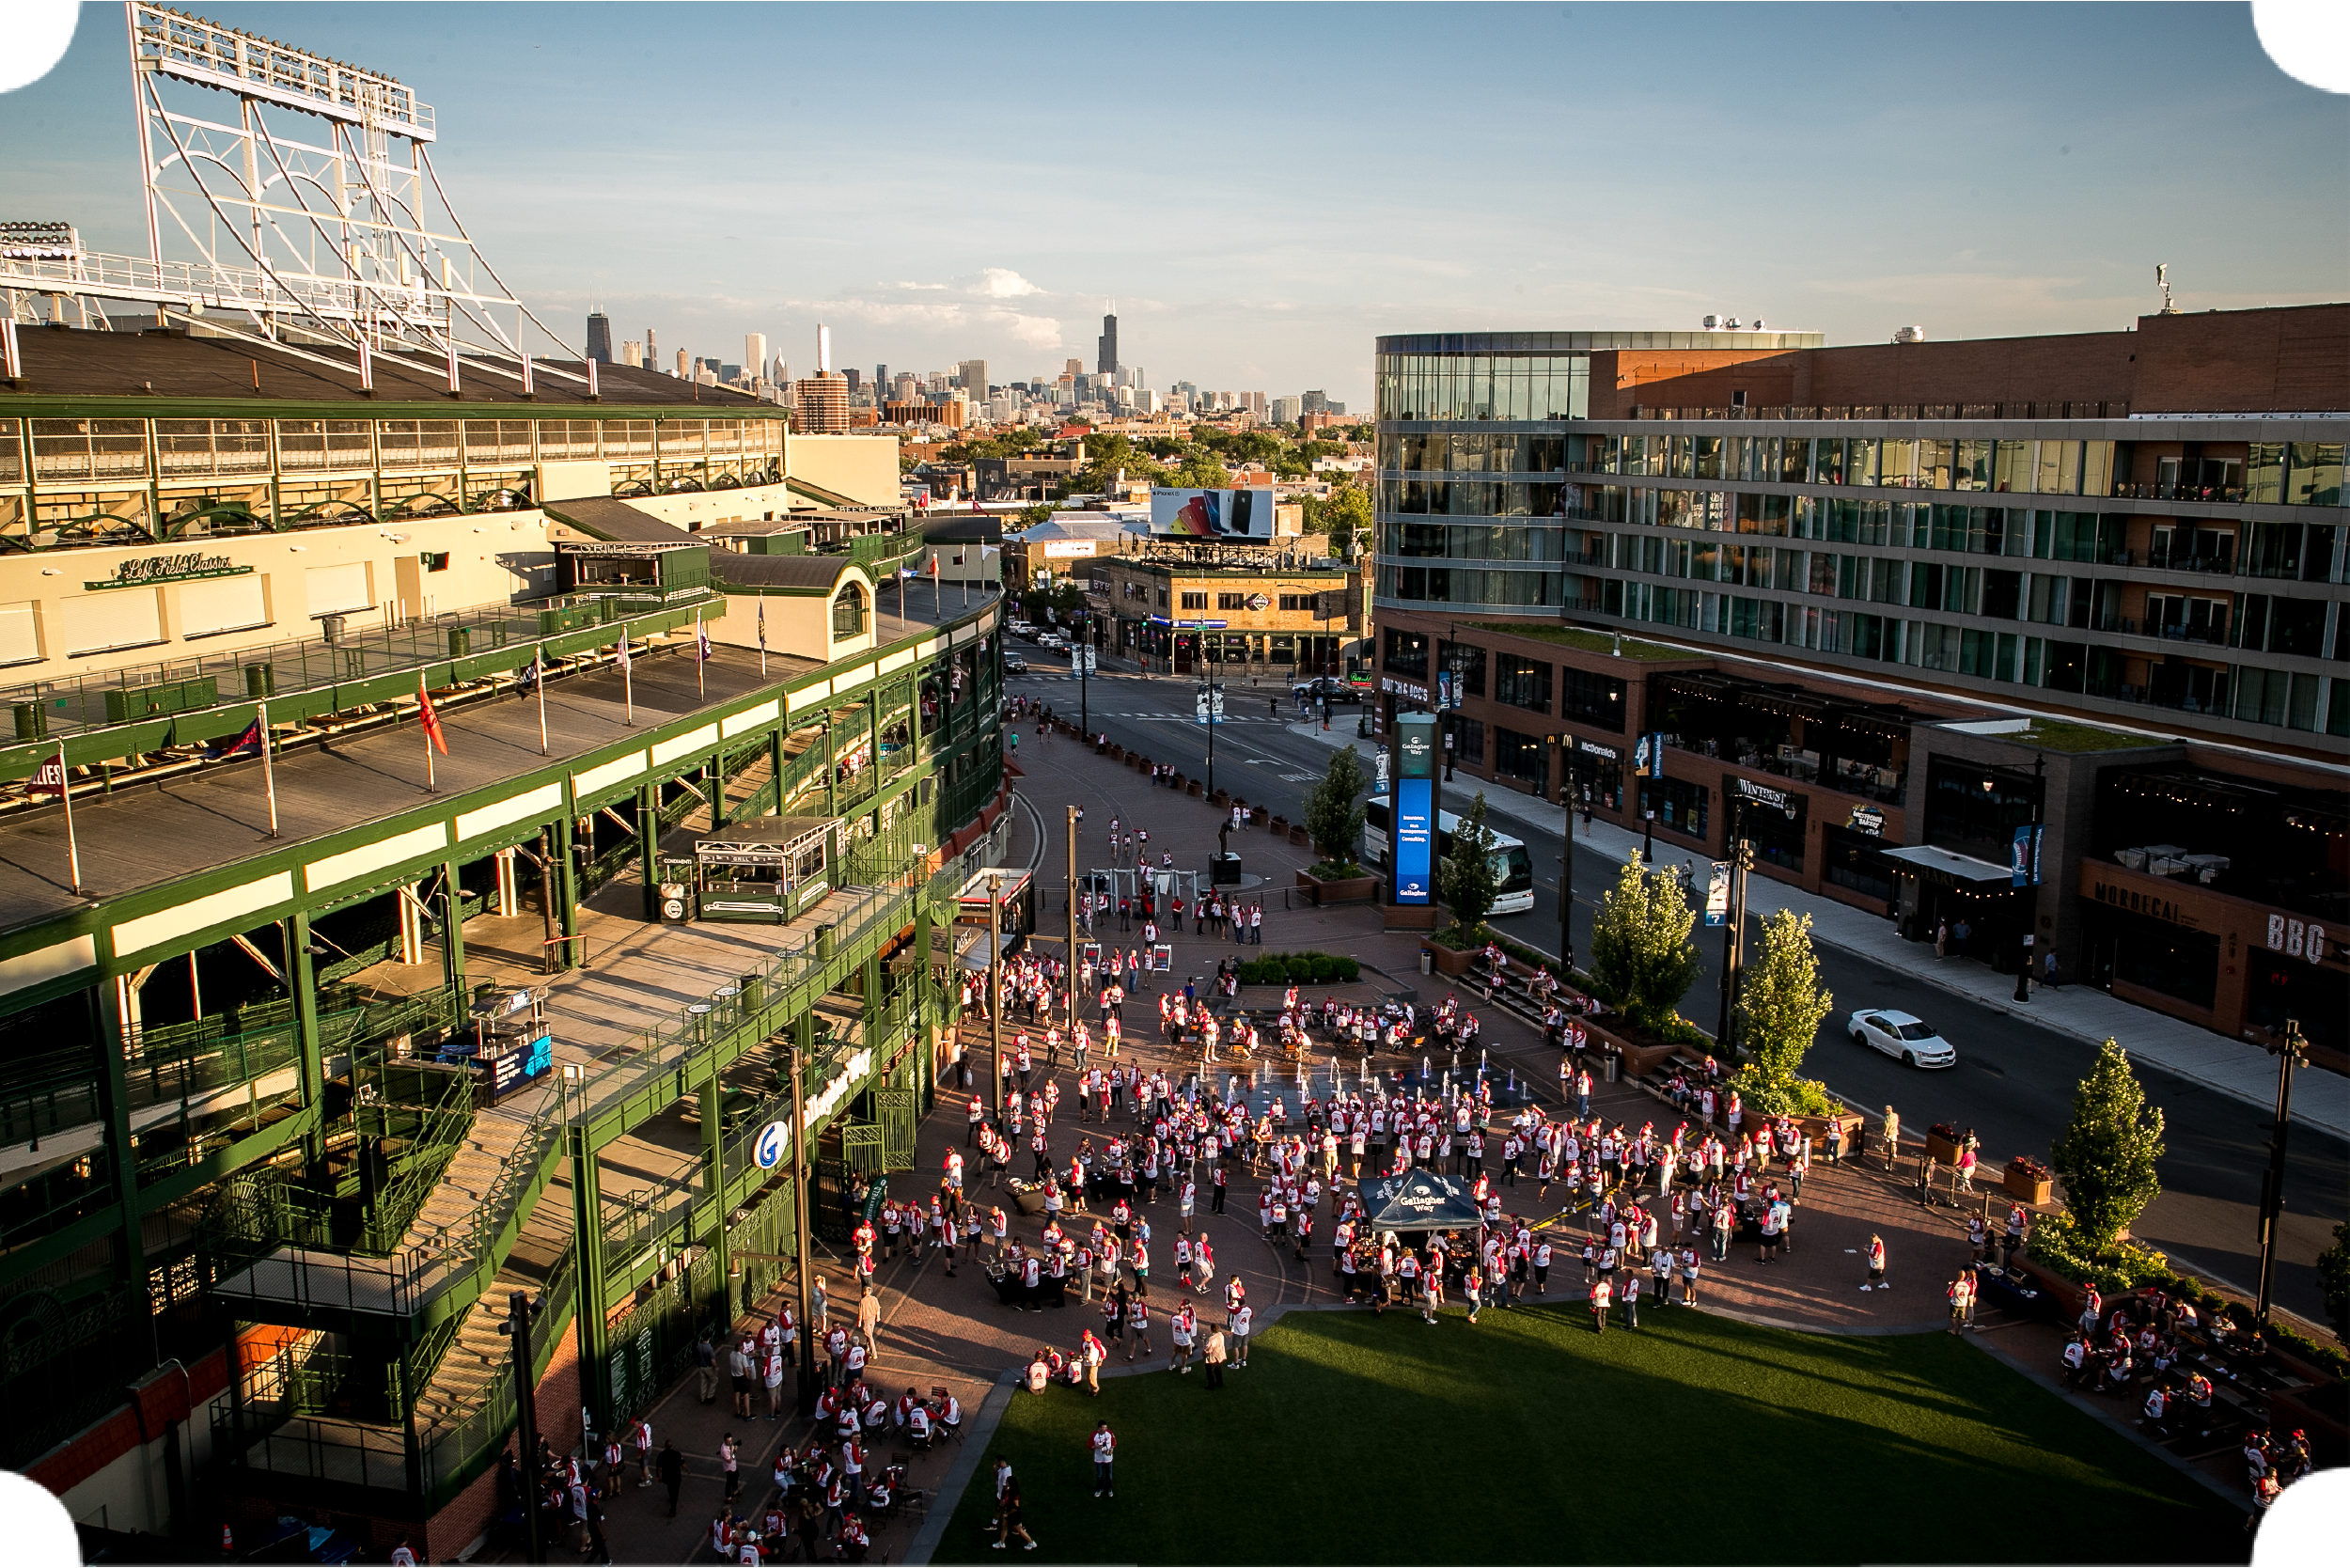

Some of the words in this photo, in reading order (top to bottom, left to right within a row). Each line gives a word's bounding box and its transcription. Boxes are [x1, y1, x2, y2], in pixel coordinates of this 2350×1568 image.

[580, 543, 634, 555] GRILL
[125, 558, 154, 582] Left
[155, 554, 189, 576] Field
[1581, 741, 1617, 760] McDonald's
[1739, 778, 1787, 804] WINTRUST
[1893, 857, 1958, 888] ZACHARY
[2094, 881, 2180, 923] MORDECAI
[2267, 913, 2326, 965] BBQ
[788, 1070, 849, 1137] allagher
[1400, 1196, 1446, 1206] Gallagher
